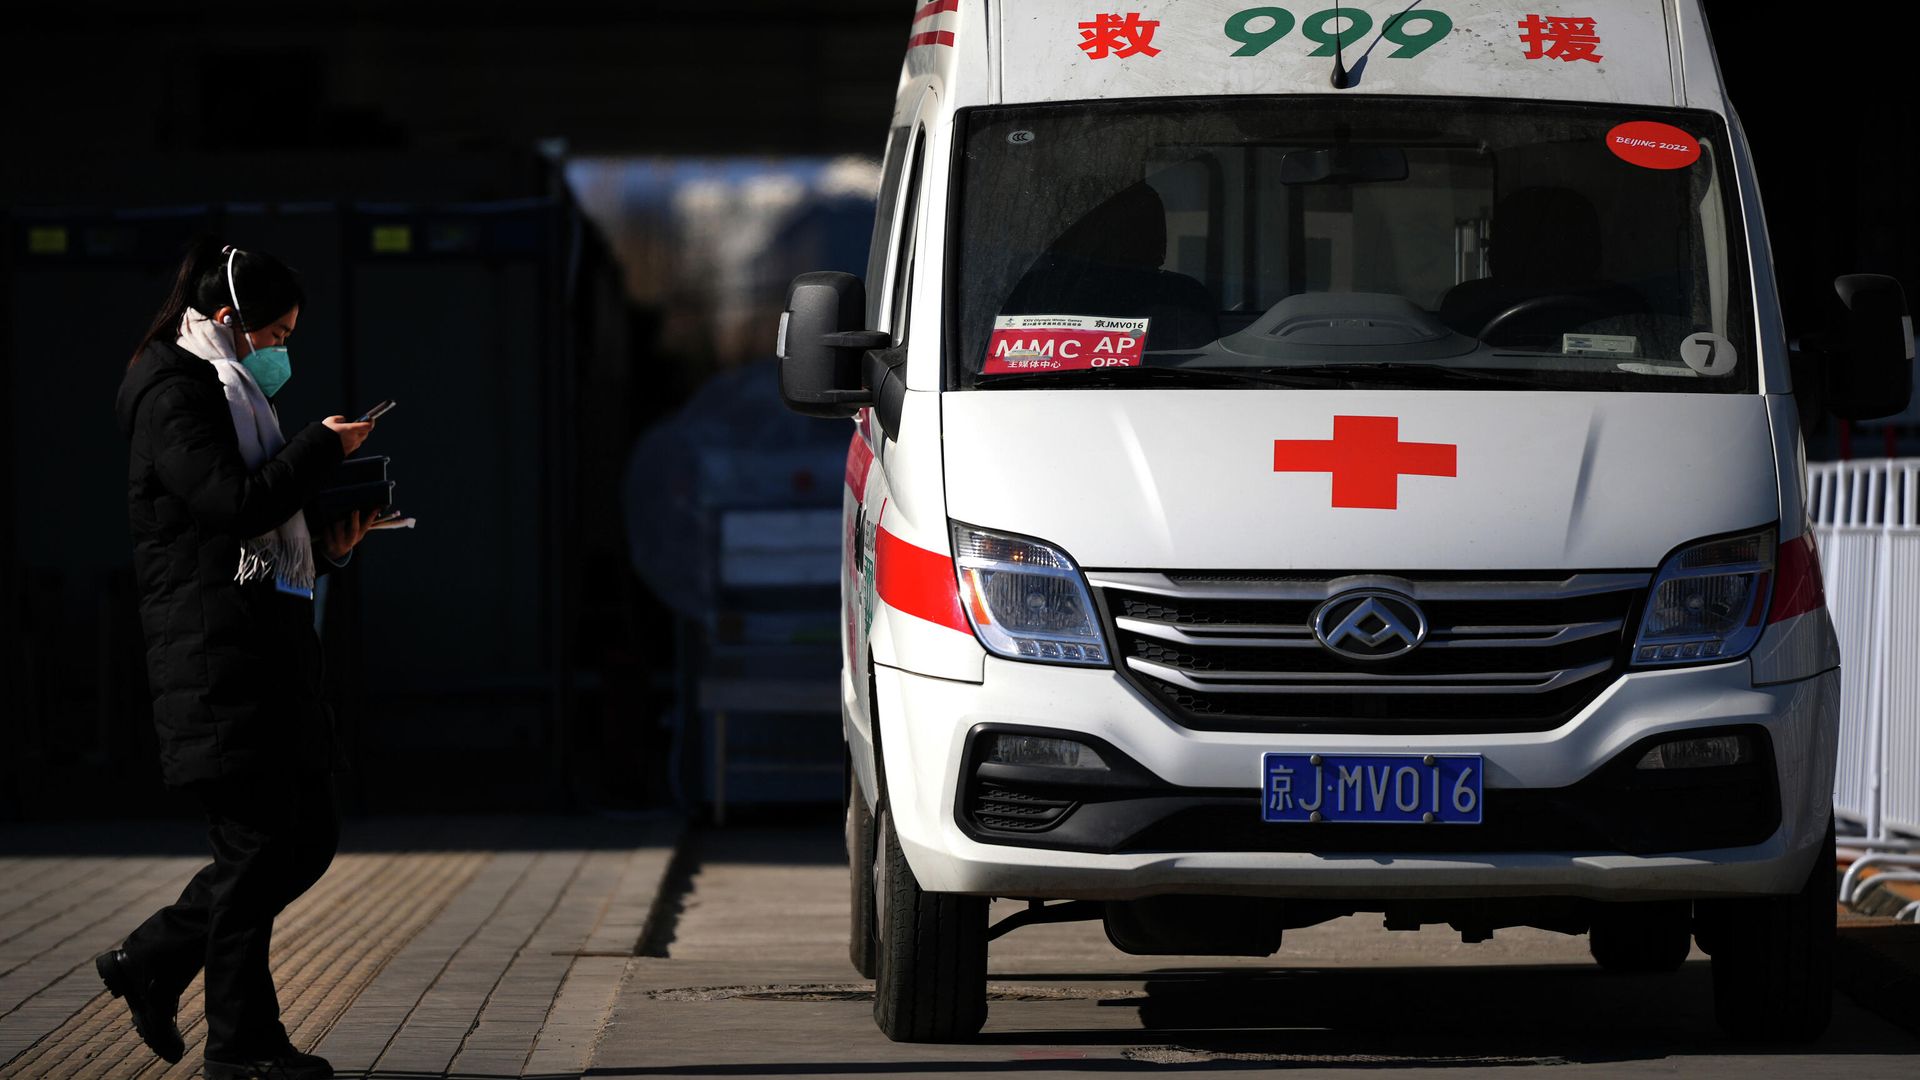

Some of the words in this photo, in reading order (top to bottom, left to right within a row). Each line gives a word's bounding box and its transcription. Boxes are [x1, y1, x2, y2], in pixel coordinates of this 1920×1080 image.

[1224, 7, 1453, 58] 999
[1615, 136, 1656, 149] BEIJING
[1658, 142, 1690, 153] 2022
[995, 339, 1081, 359] MMC
[1093, 336, 1136, 354] AP
[1694, 339, 1716, 368] 7
[1007, 360, 1061, 369] 主媒体中心
[1090, 357, 1130, 367] OPS
